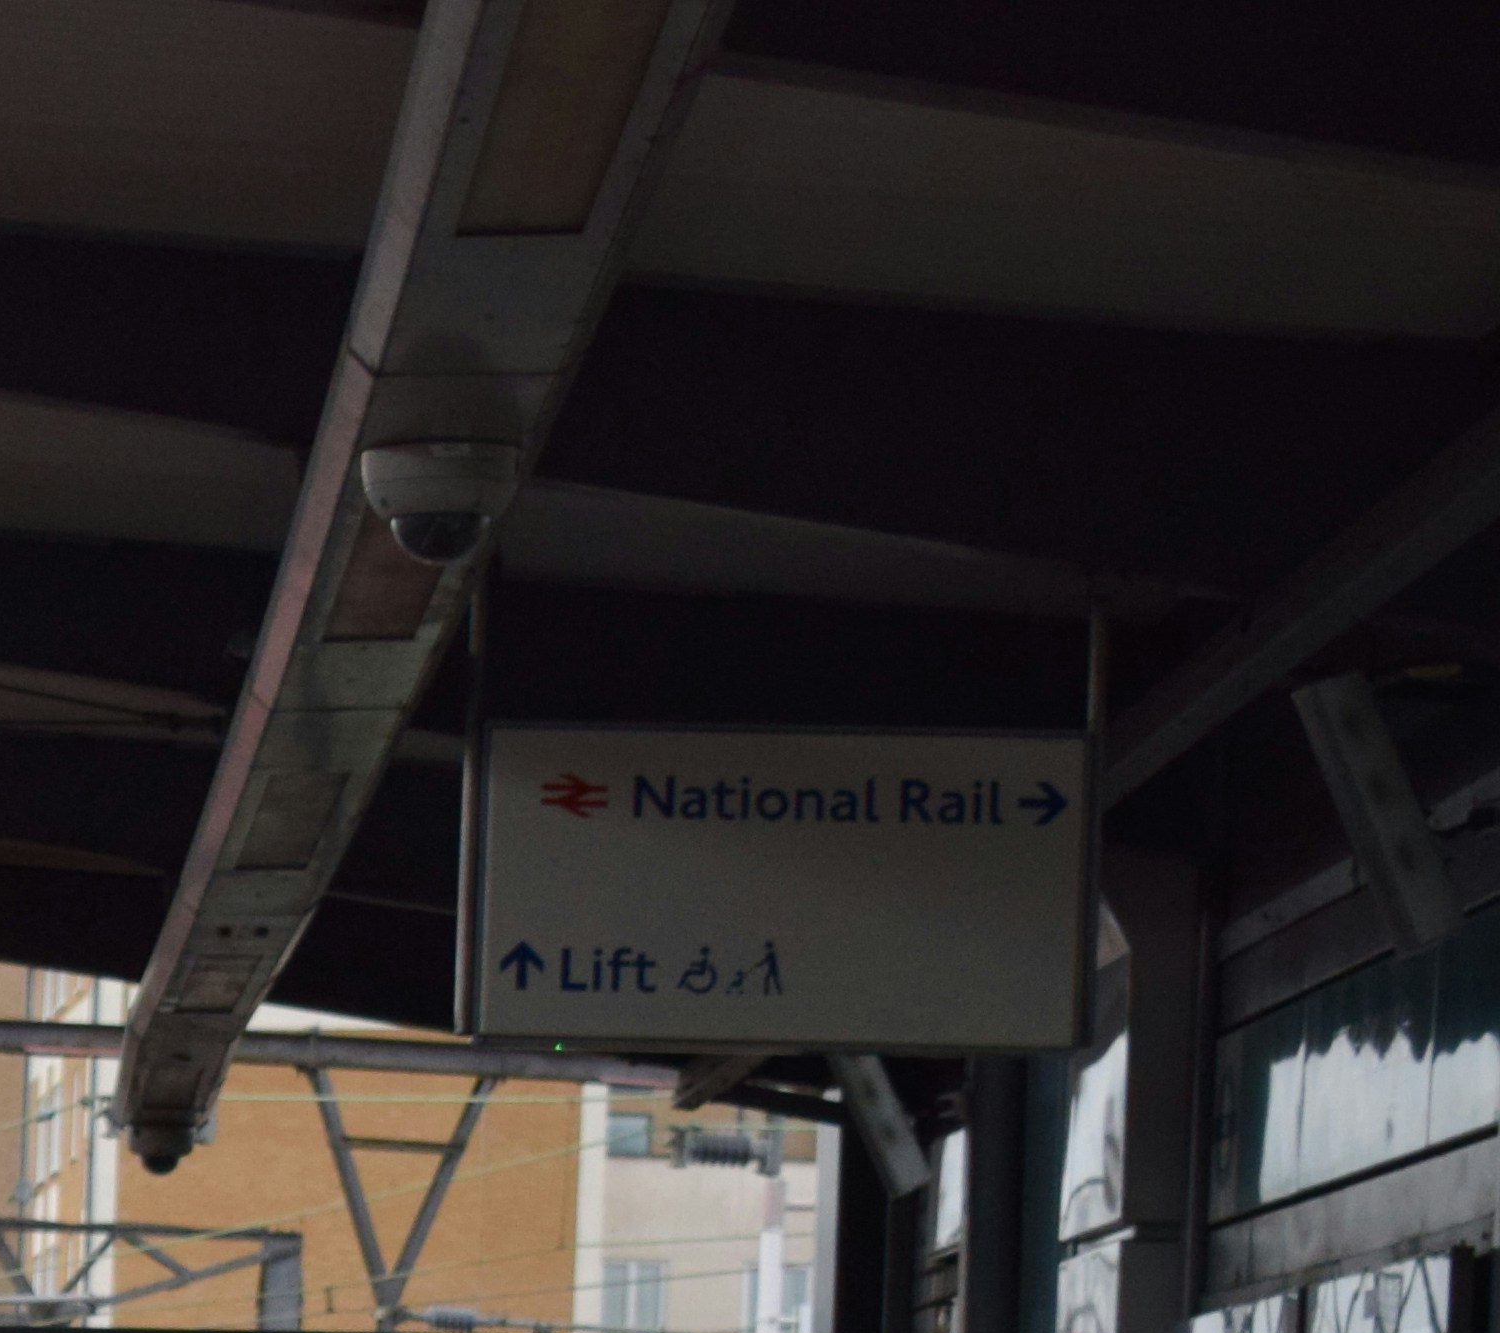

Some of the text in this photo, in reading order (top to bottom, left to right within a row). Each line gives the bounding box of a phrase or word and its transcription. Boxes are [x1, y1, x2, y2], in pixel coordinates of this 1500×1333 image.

[632, 774, 1003, 826] National Rail
[560, 946, 657, 994] Lift
